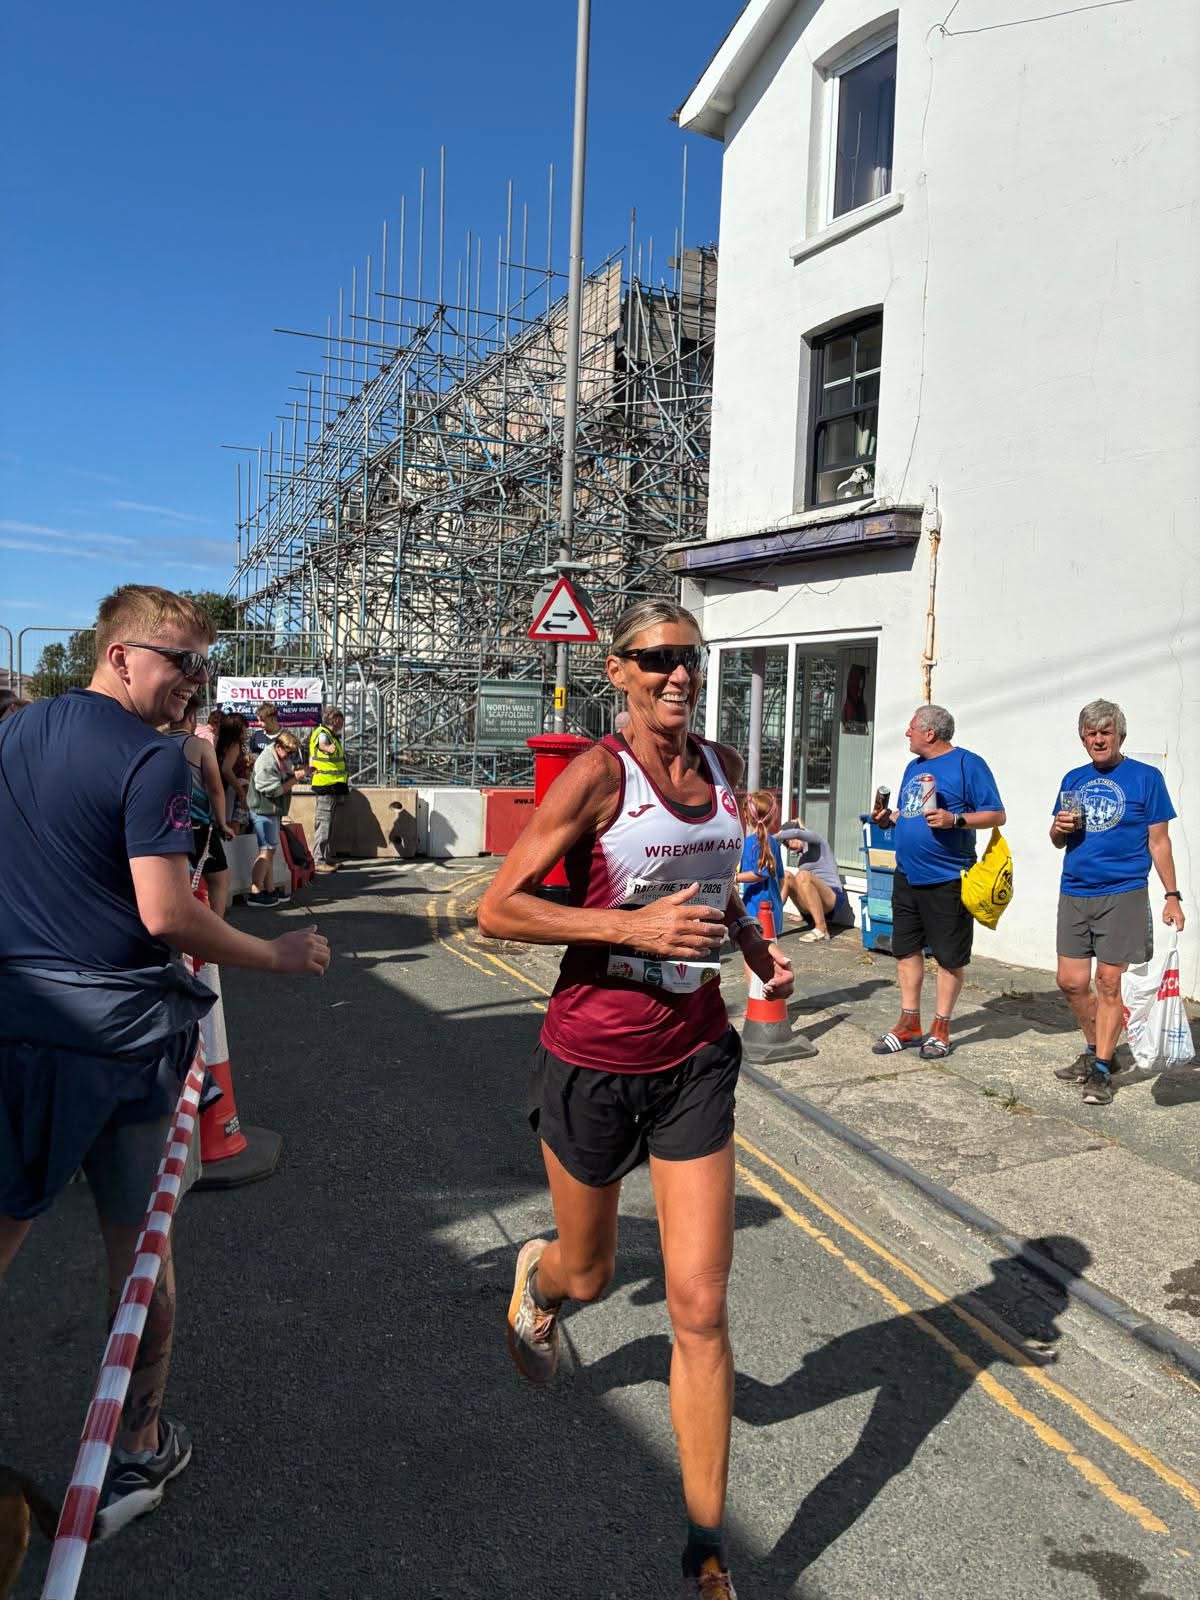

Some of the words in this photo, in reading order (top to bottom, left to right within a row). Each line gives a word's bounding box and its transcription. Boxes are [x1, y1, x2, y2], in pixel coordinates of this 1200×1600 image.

[251, 679, 284, 688] WE'RE
[230, 688, 264, 700] STILL
[267, 688, 307, 700] OPEN!
[488, 711, 535, 719] SCAFFOLDING
[645, 840, 715, 858] WREXHAM
[717, 838, 742, 851] AAC
[658, 883, 677, 892] THE
[702, 883, 722, 894] 2026
